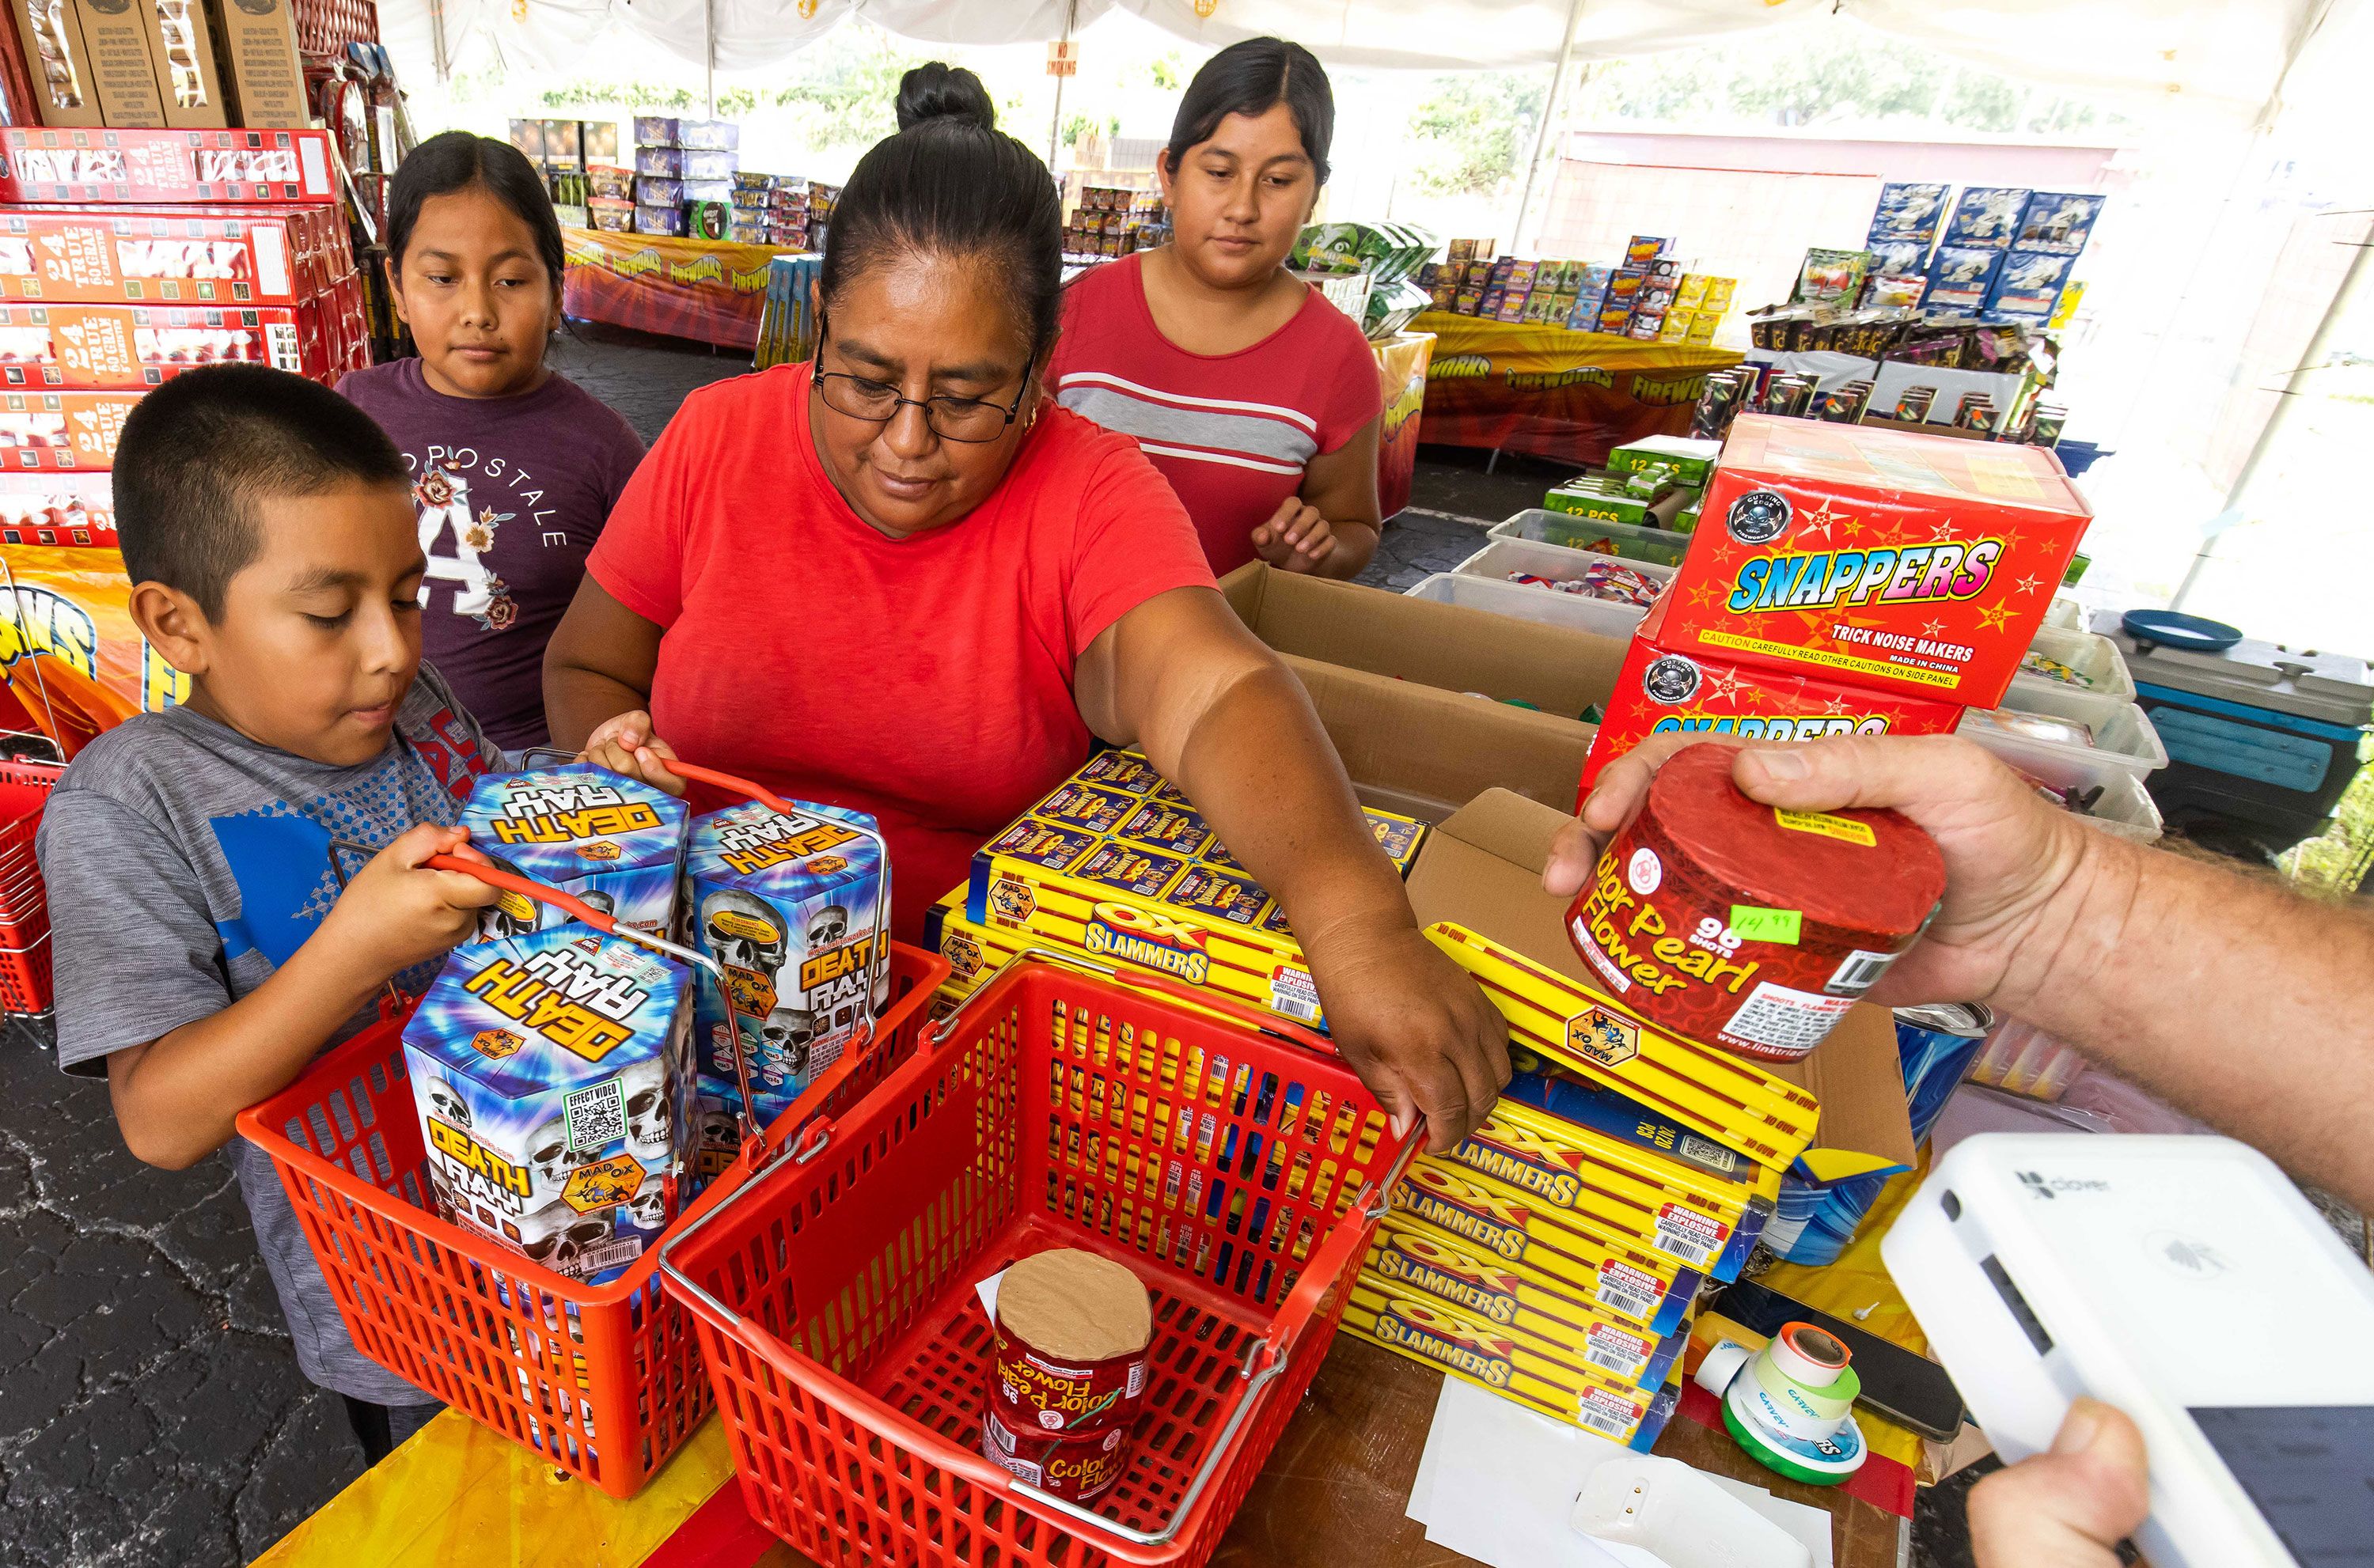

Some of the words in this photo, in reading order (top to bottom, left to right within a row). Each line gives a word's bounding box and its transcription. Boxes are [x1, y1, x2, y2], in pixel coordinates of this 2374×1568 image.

[1057, 43, 1068, 59] NO
[1046, 61, 1076, 75] SMOKING
[40, 235, 72, 281] 24
[63, 227, 89, 288] TRUE
[80, 228, 100, 267] GRAM
[89, 268, 103, 286] 60
[59, 324, 91, 369] 24
[82, 316, 105, 376] TRUE
[97, 317, 118, 354] GRAM
[108, 355, 120, 373] 60
[1507, 367, 1616, 392] FIREWORKS
[73, 407, 104, 453] 24
[1630, 459, 1647, 472] 12
[1746, 494, 1782, 506] CUTTING
[1754, 499, 1775, 508] EDGE
[1588, 509, 1619, 523] PCS
[416, 475, 494, 615] A
[1737, 528, 1769, 540] FIREWORKS
[1727, 539, 2003, 613] SNAPPERS
[1832, 624, 1870, 643] TRICK
[1873, 630, 1915, 650] NOISE
[1914, 637, 1974, 662] MAKERS
[1661, 660, 1692, 672] CUTTING
[1667, 664, 1685, 673] EDGE
[1702, 632, 1750, 648] CAUTION
[1751, 641, 1798, 658] CAREFULLY
[1798, 650, 1820, 662] READ
[1821, 653, 1849, 668] OTHER
[1849, 658, 1892, 675] CAUTIONS
[1892, 666, 1906, 677] ON
[1906, 668, 1927, 681] SIDE
[1926, 672, 1955, 687] PANEL
[1889, 654, 1916, 666] MADE
[1917, 659, 1928, 668] IN
[1928, 661, 1959, 673] CHINA
[1652, 689, 1680, 701] FIREWORKS
[1118, 763, 1143, 784] OX
[502, 784, 625, 819] RAY
[1077, 797, 1107, 820] OX
[490, 801, 665, 844] DEATH
[1162, 817, 1189, 841] OX
[719, 824, 862, 875] DEATH
[1033, 835, 1065, 857] OX
[1002, 870, 1016, 882] MAD
[1121, 858, 1151, 883] OX
[1000, 882, 1021, 894] MAD
[1018, 892, 1030, 902] OX
[1213, 884, 1242, 909] OX
[996, 917, 1011, 928] MAD
[1092, 902, 1208, 953] OX
[1696, 916, 1743, 949] 96
[952, 939, 969, 952] MAD
[1086, 921, 1210, 985] SLAMMERS
[1582, 888, 1688, 995] Flower
[1628, 903, 1760, 994] Pearl
[1689, 934, 1734, 959] SHOTS
[800, 929, 889, 992] DEATH
[965, 949, 979, 959] OX
[521, 949, 650, 1021] RAY
[727, 967, 755, 981] MAD
[751, 981, 771, 994] OX
[809, 962, 882, 1013] RAY
[1272, 987, 1291, 997] WARNING
[1274, 981, 1296, 992] CAREFULLY
[1296, 987, 1307, 996] READ
[1760, 993, 1796, 1006] SHOOTS
[462, 957, 635, 1063] DEATH
[1572, 1028, 1592, 1044] OX
[483, 1045, 500, 1058] MAD
[1583, 1044, 1613, 1062] MAD
[569, 1090, 595, 1107] EFFECT
[595, 1083, 617, 1098] VIDEO
[1784, 1090, 1796, 1101] OX
[1796, 1097, 1818, 1112] MAD
[1636, 1121, 1656, 1139] PCS
[1763, 1114, 1775, 1126] OX
[1776, 1120, 1798, 1135] MAD
[1654, 1125, 1677, 1149] 24/120
[1743, 1138, 1754, 1149] OX
[427, 1115, 533, 1197] DEATH
[1755, 1144, 1777, 1158] MAD
[578, 1163, 614, 1181] MAD
[610, 1164, 634, 1180] OX
[442, 1152, 523, 1217] RAY
[1401, 1162, 1531, 1233] OX
[1686, 1193, 1707, 1208] MAD
[1707, 1201, 1721, 1212] OX
[1388, 1180, 1530, 1262] SLAMMERS
[1667, 1211, 1719, 1238] EXPLOSIVE
[1672, 1205, 1720, 1229] WARNING
[1658, 1224, 1679, 1237] WARNING
[1688, 1235, 1700, 1244] SIDE
[1700, 1240, 1716, 1252] PANEL
[1661, 1219, 1687, 1234] CAREFULLY
[1688, 1229, 1701, 1238] READ
[1701, 1234, 1718, 1246] OTHER
[1390, 1233, 1520, 1296] OX
[1614, 1261, 1658, 1286] WARNING
[1378, 1248, 1520, 1326] SLAMMERS
[1599, 1278, 1621, 1292] WARNING
[1629, 1290, 1640, 1299] SIDE
[1639, 1295, 1654, 1306] PANEL
[1602, 1274, 1627, 1289] CAREFULLY
[1628, 1284, 1640, 1293] READ
[1640, 1290, 1656, 1300] OTHER
[1608, 1267, 1657, 1293] EXPLOSIVE
[1386, 1299, 1514, 1360] OX
[1602, 1324, 1644, 1346] WARNING
[1375, 1313, 1513, 1389] SLAMMERS
[1588, 1340, 1609, 1352] WARNING
[1626, 1355, 1640, 1365] PANEL
[1591, 1336, 1615, 1350] CAREFULLY
[1615, 1346, 1628, 1354] READ
[1627, 1351, 1642, 1360] OTHER
[1596, 1331, 1643, 1354] EXPLOSIVE
[1011, 1359, 1090, 1397] Flower
[1003, 1384, 1018, 1405] 96
[1589, 1395, 1635, 1416] EXPLOSIVE
[1593, 1387, 1636, 1410] WARNING
[1788, 1388, 1818, 1418] GARVEY
[1759, 1392, 1788, 1427] GARVEY
[1049, 1454, 1113, 1479] Color
